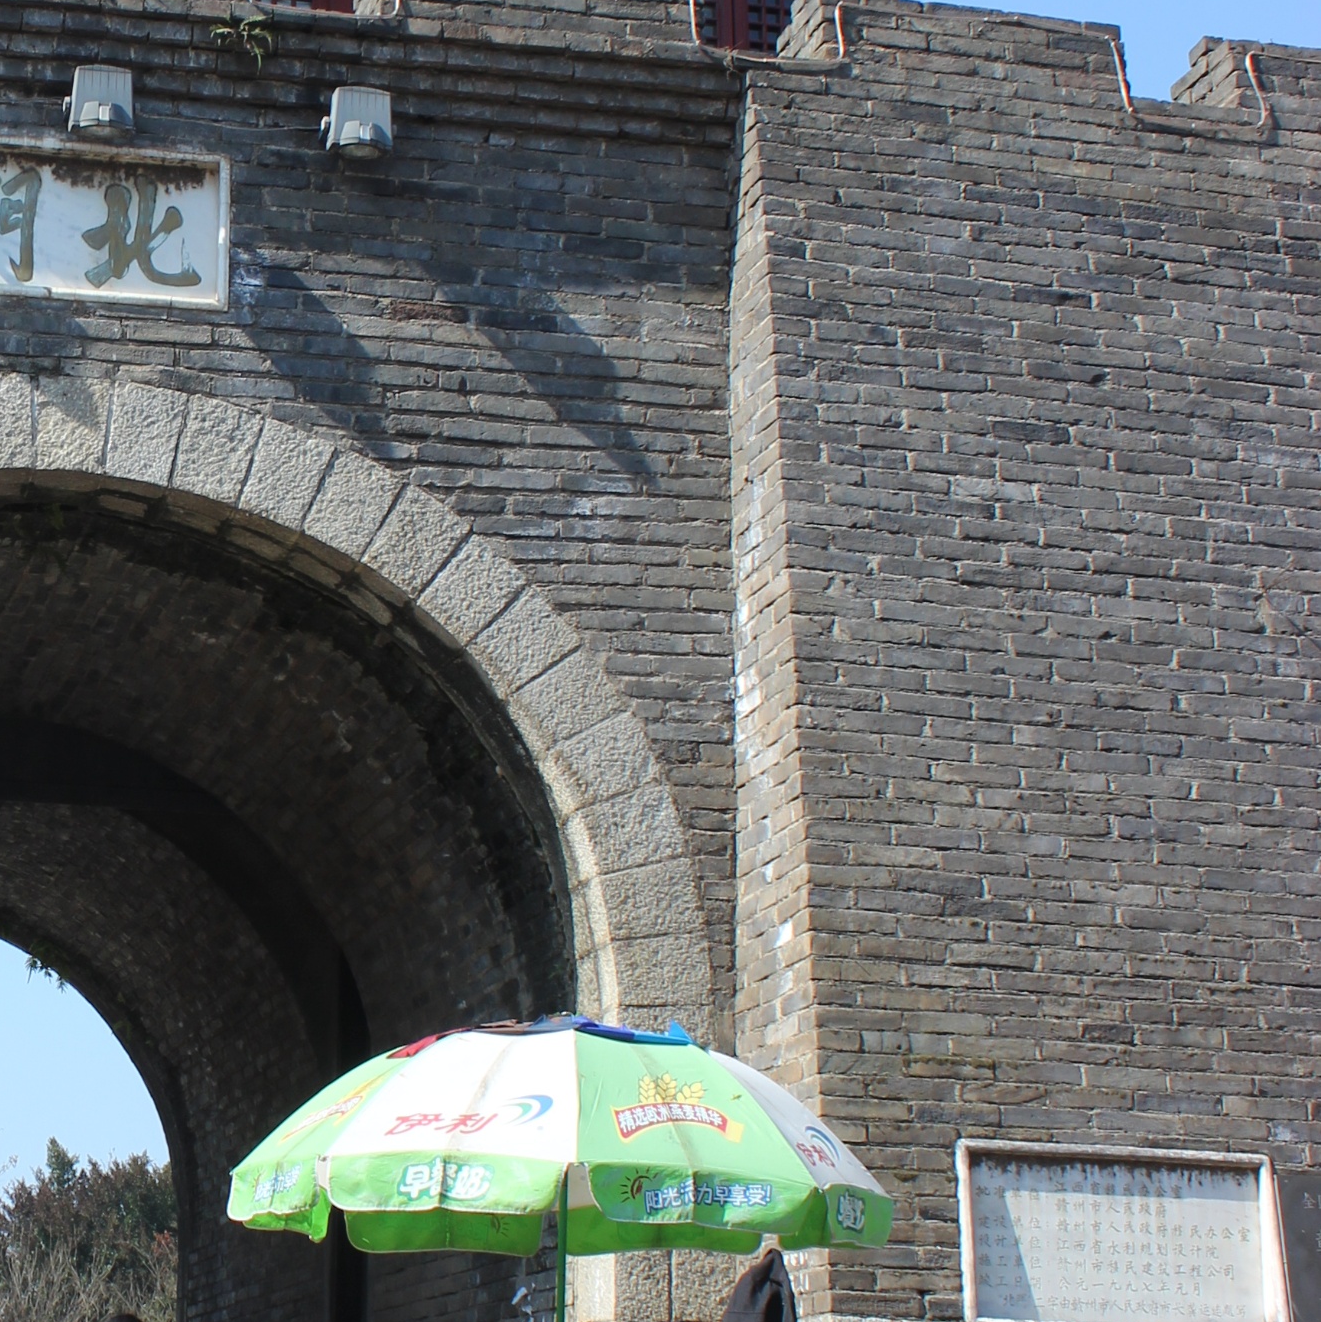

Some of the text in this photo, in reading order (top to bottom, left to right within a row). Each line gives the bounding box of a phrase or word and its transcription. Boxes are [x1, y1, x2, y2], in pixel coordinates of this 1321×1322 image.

[383, 1111, 506, 1136] 伊利
[618, 1103, 726, 1134] 精选欧洲燕麦精华
[400, 1155, 491, 1199] 早餐奶
[1303, 1190, 1321, 1210] 全
